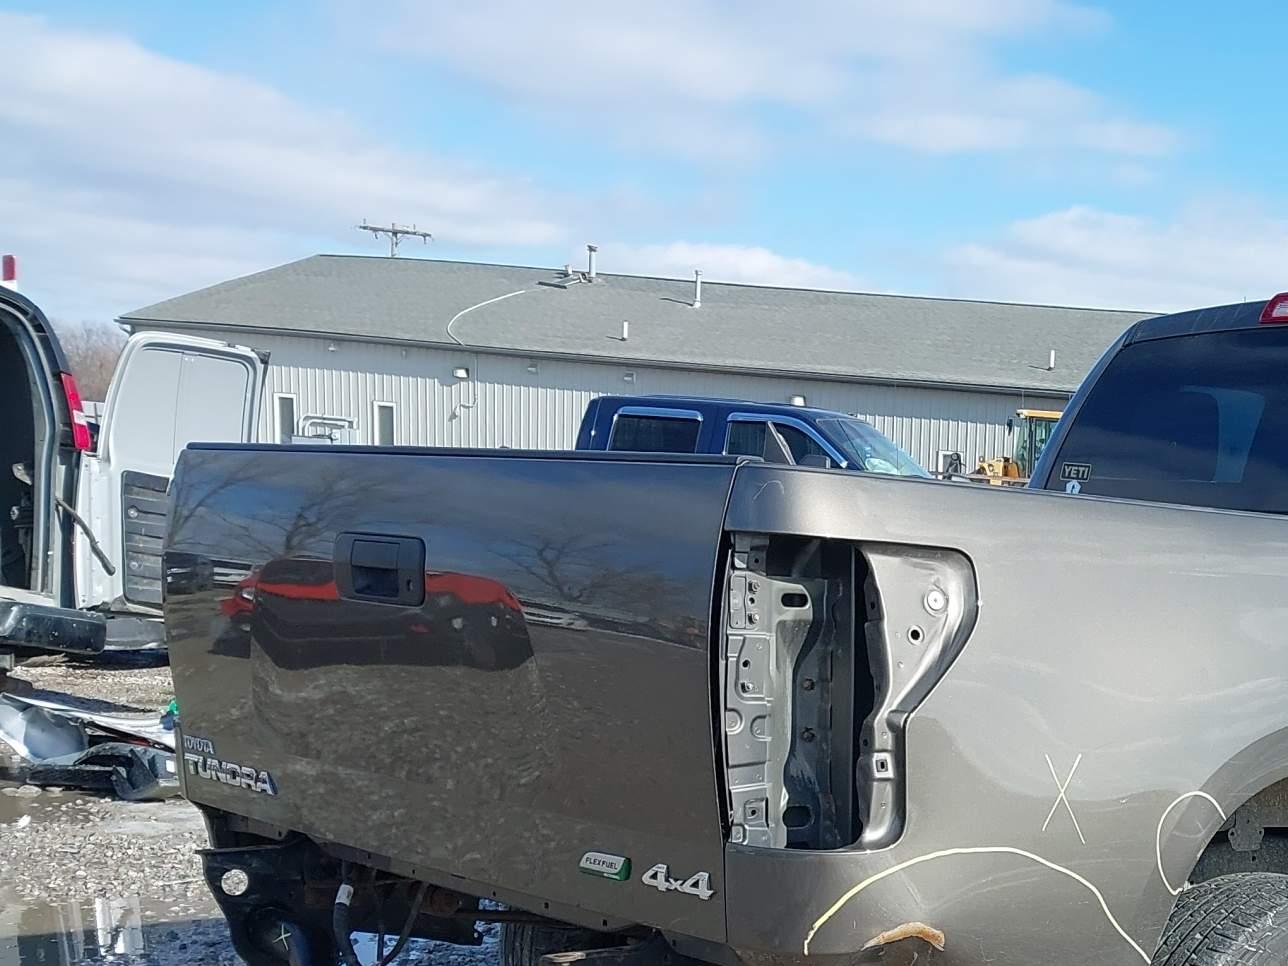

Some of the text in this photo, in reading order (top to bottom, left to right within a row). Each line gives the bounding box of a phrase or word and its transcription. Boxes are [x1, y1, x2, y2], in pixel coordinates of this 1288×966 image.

[1064, 465, 1089, 479] YETI
[184, 752, 277, 796] TUNDRA
[585, 856, 618, 870] FLEX FUEL
[642, 863, 715, 900] 4x4
